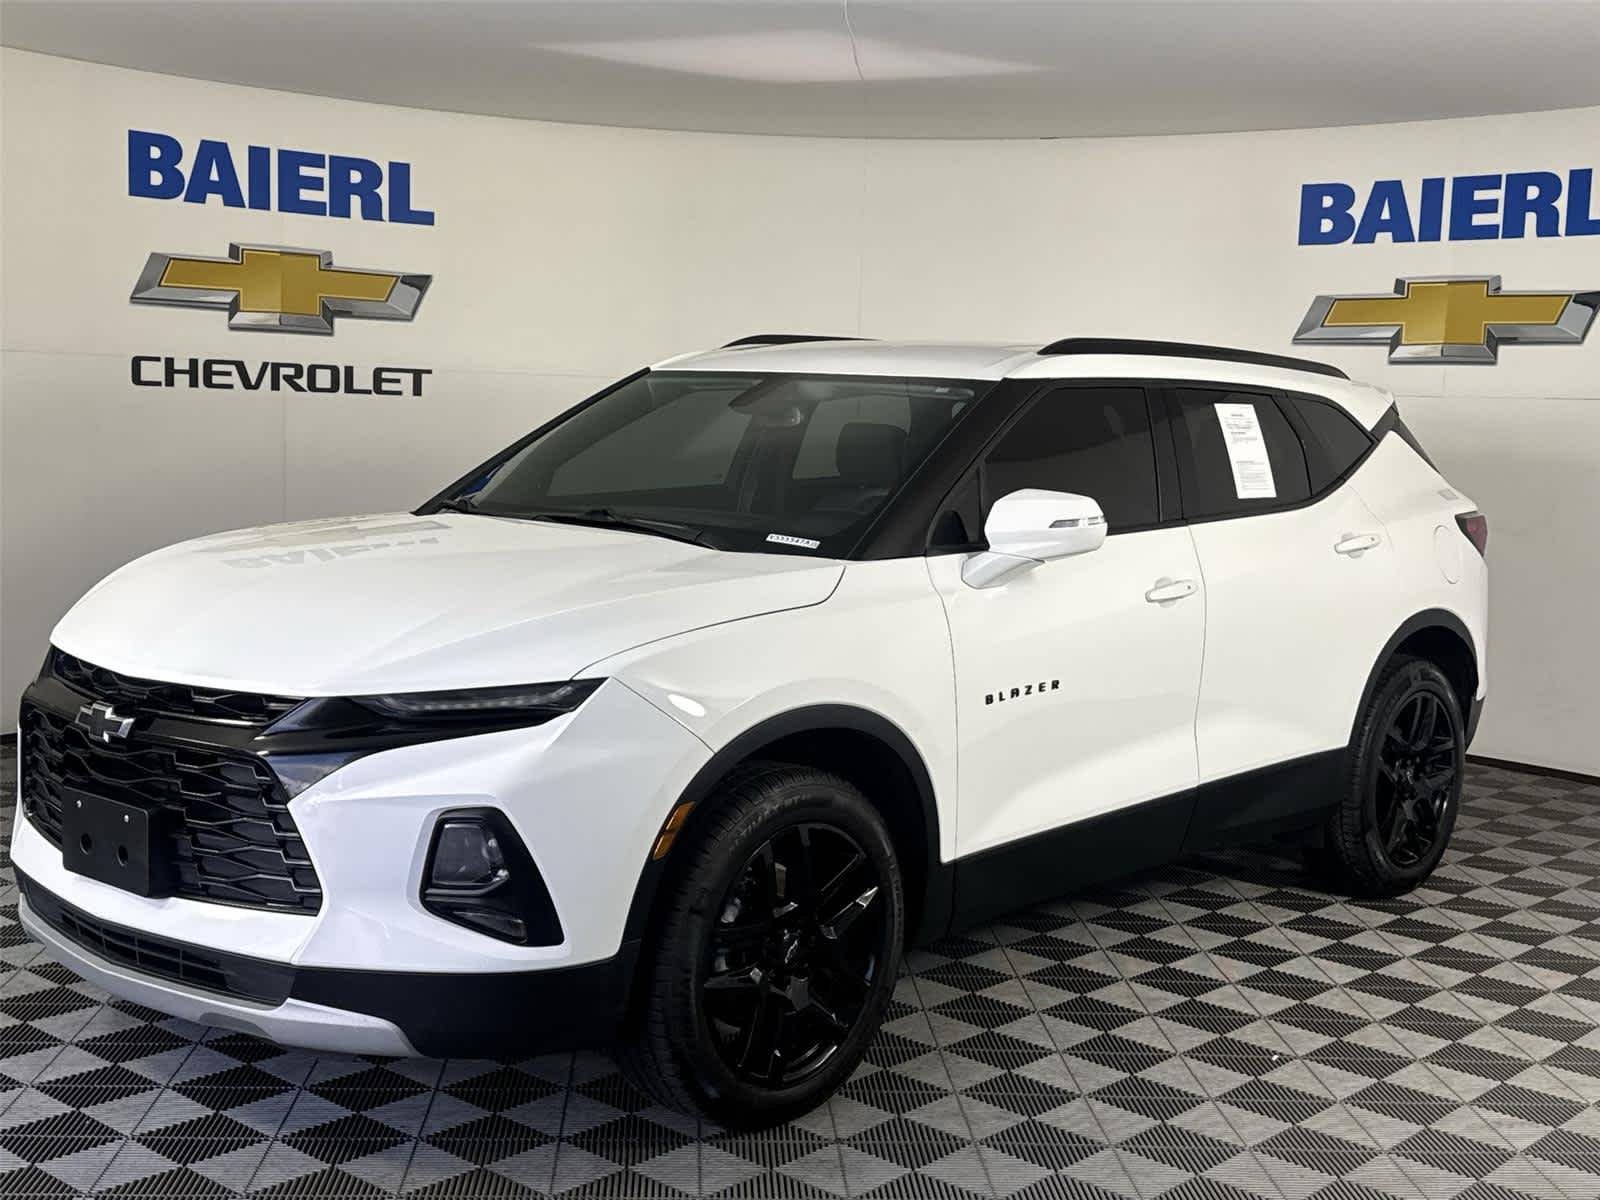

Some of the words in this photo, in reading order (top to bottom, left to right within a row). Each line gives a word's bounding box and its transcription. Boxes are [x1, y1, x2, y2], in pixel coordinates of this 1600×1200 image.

[128, 130, 434, 225] BAIERL
[1298, 168, 1600, 246] BAIERL
[131, 355, 433, 397] CHEVROLET
[985, 679, 1061, 705] BLAZER
